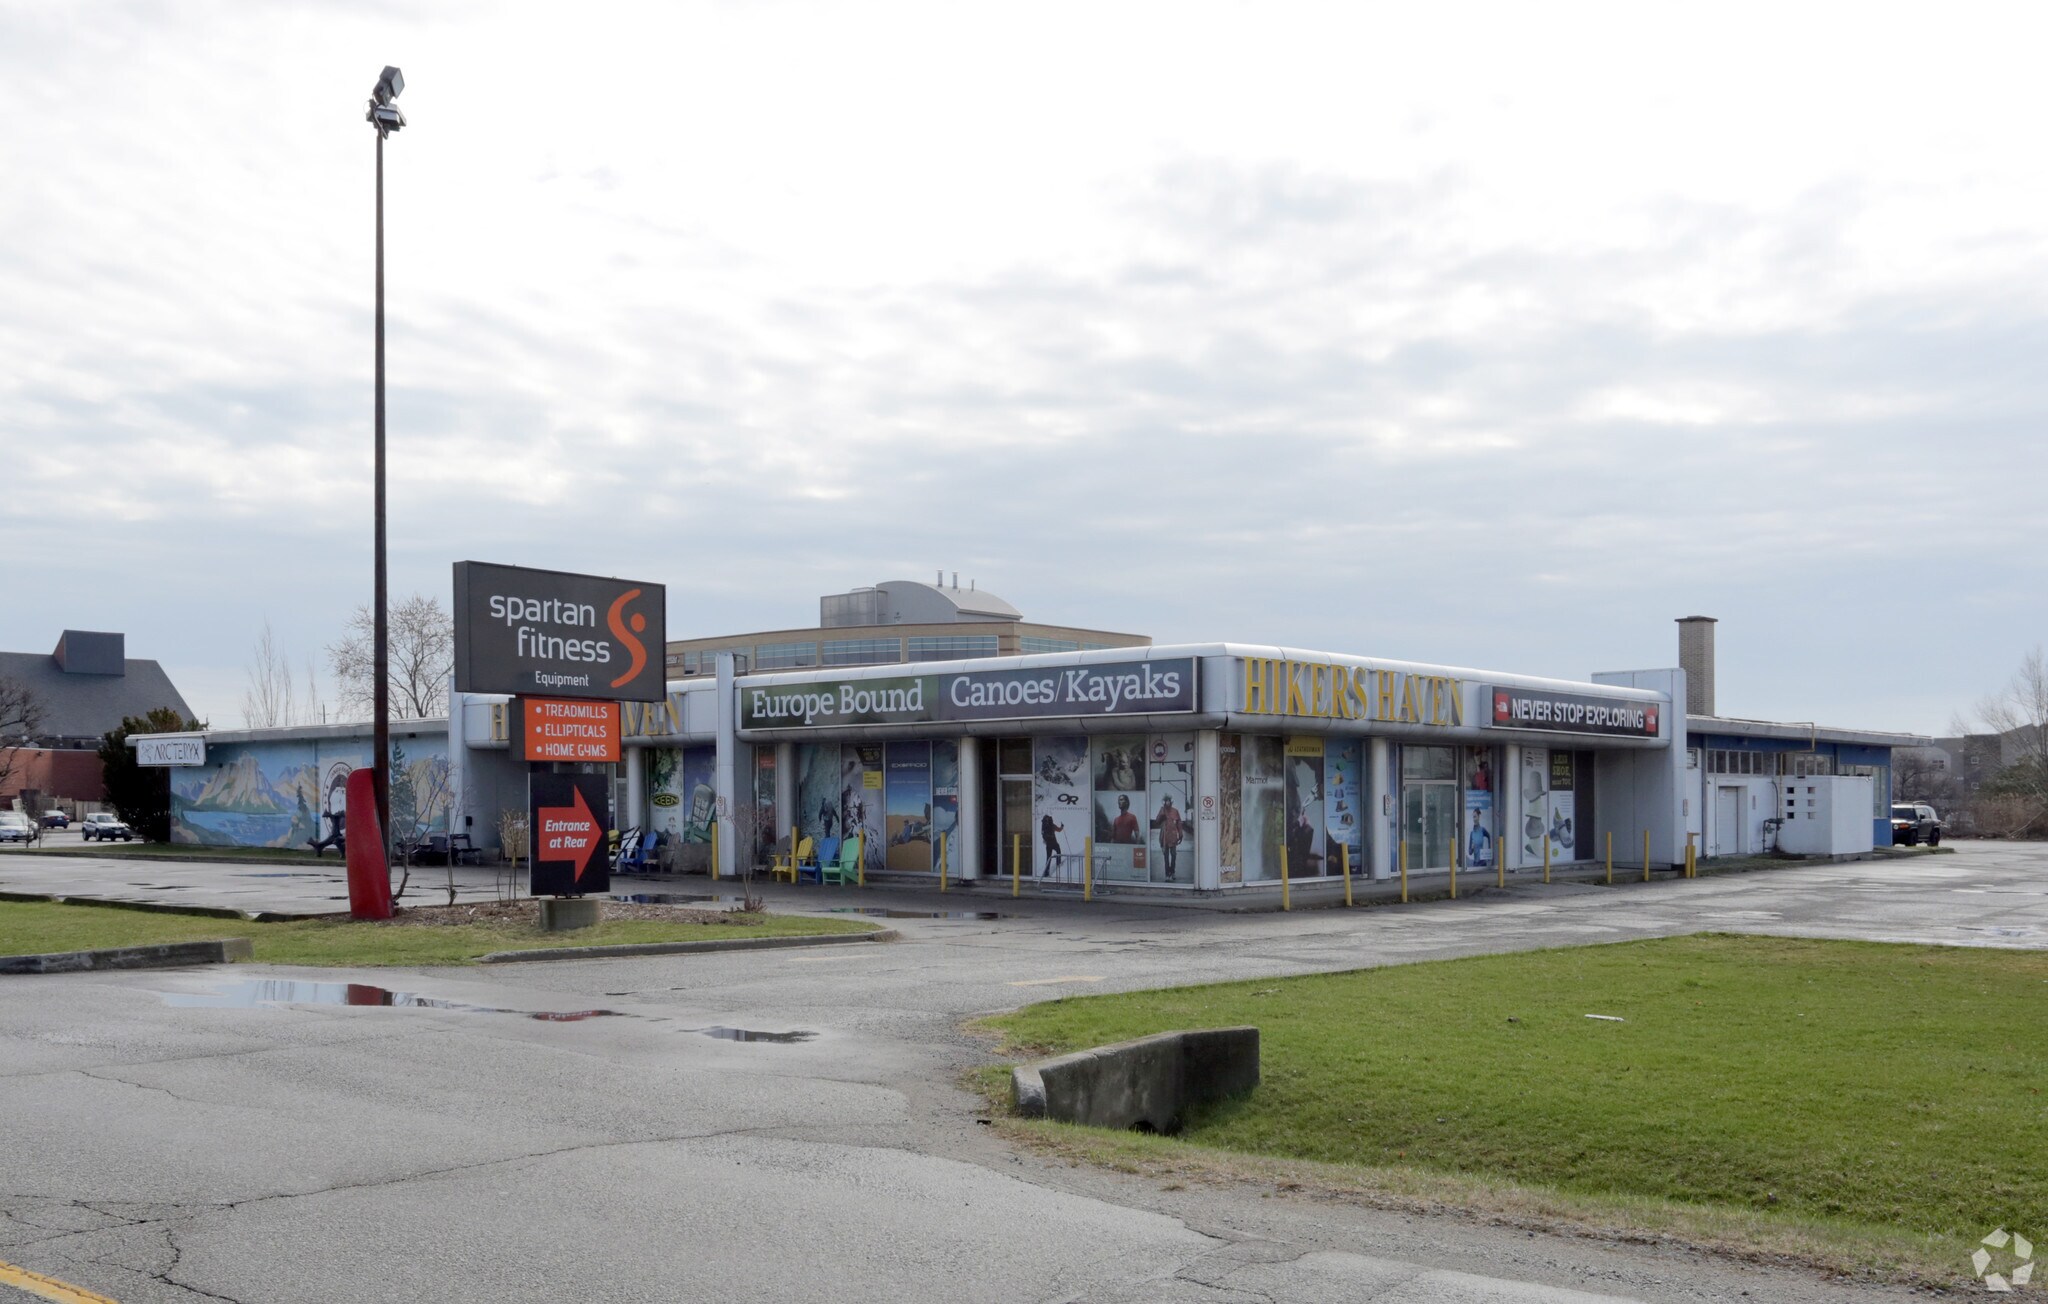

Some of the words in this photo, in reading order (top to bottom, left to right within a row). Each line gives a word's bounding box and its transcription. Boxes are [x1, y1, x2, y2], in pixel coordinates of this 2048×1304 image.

[489, 595, 595, 627] spartan
[518, 626, 611, 663] fitness
[535, 670, 589, 688] Equipment
[950, 664, 1181, 711] Canoes/Kayaks
[1243, 656, 1368, 720] HIKERS
[1375, 669, 1464, 727] HAVEN
[752, 689, 835, 724] Europe
[839, 679, 924, 714] Bound
[545, 703, 608, 719] TREADMILLS
[1512, 698, 1551, 721] NEVER
[1554, 703, 1584, 723] STOP
[1586, 705, 1644, 729] EXPLORING
[545, 723, 607, 738] ELLIPTICALS
[545, 743, 575, 757] HOME
[577, 744, 607, 757] GYMS
[655, 795, 678, 806] KEEN
[545, 819, 591, 832] Entrance
[549, 837, 562, 849] at
[564, 836, 588, 848] Rear
